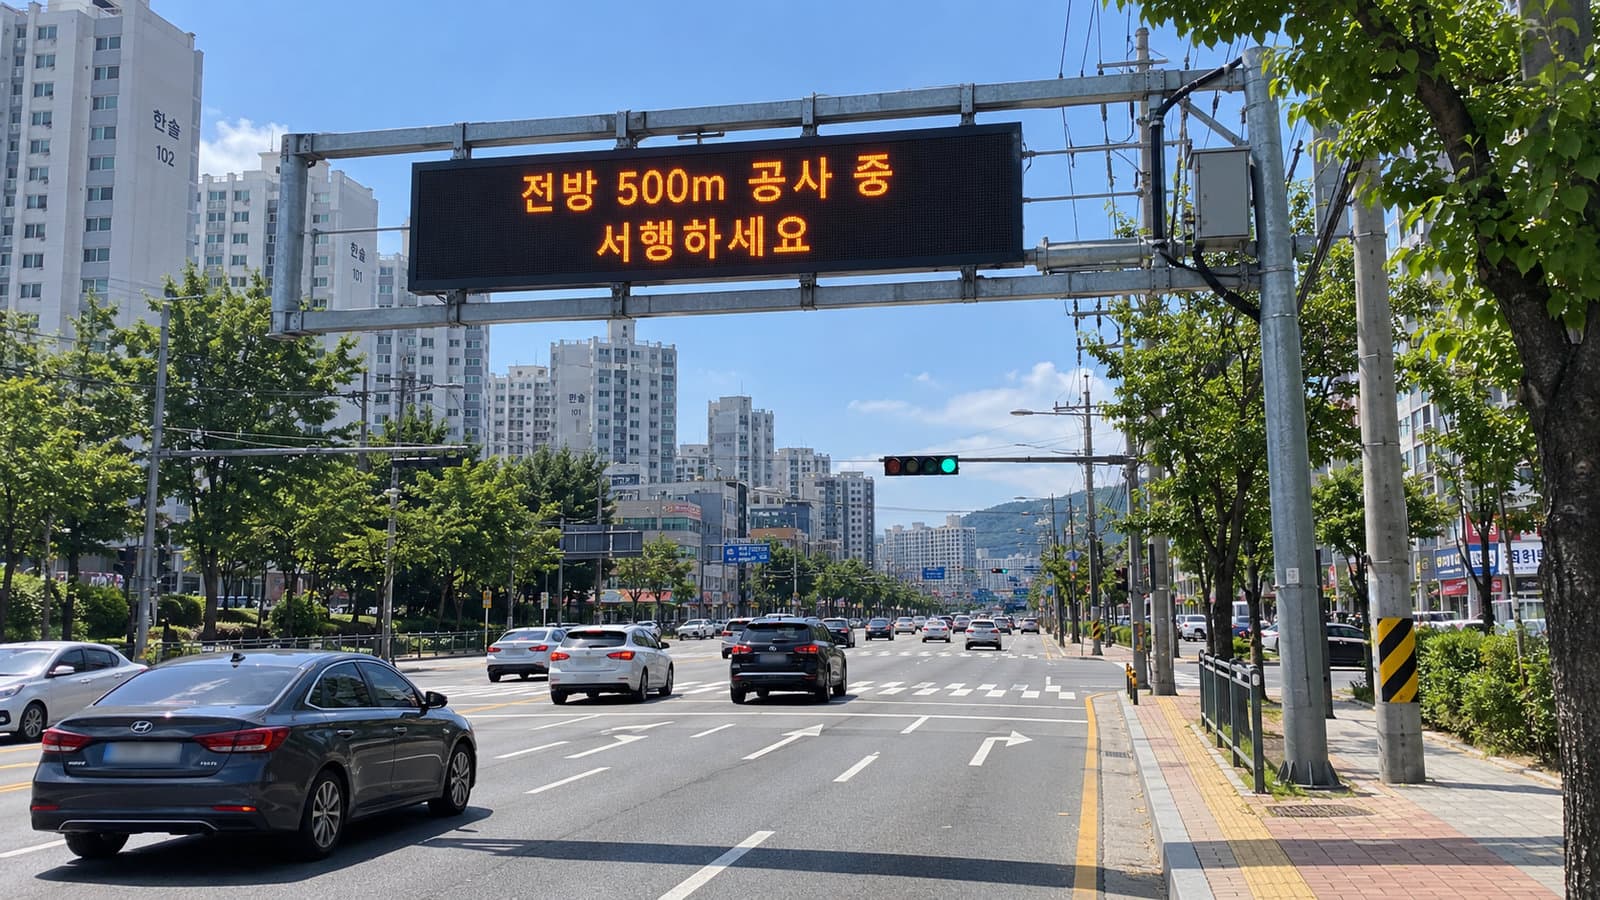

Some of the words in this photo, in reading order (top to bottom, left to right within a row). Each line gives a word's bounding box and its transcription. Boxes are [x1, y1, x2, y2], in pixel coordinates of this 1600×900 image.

[153, 109, 181, 141] 한솔
[156, 145, 175, 168] 102
[521, 170, 598, 213] 전방
[617, 167, 725, 206] 500m
[748, 157, 833, 203] 공사
[853, 153, 893, 197] 중
[597, 216, 811, 263] 서행하세요
[352, 268, 363, 283] 101
